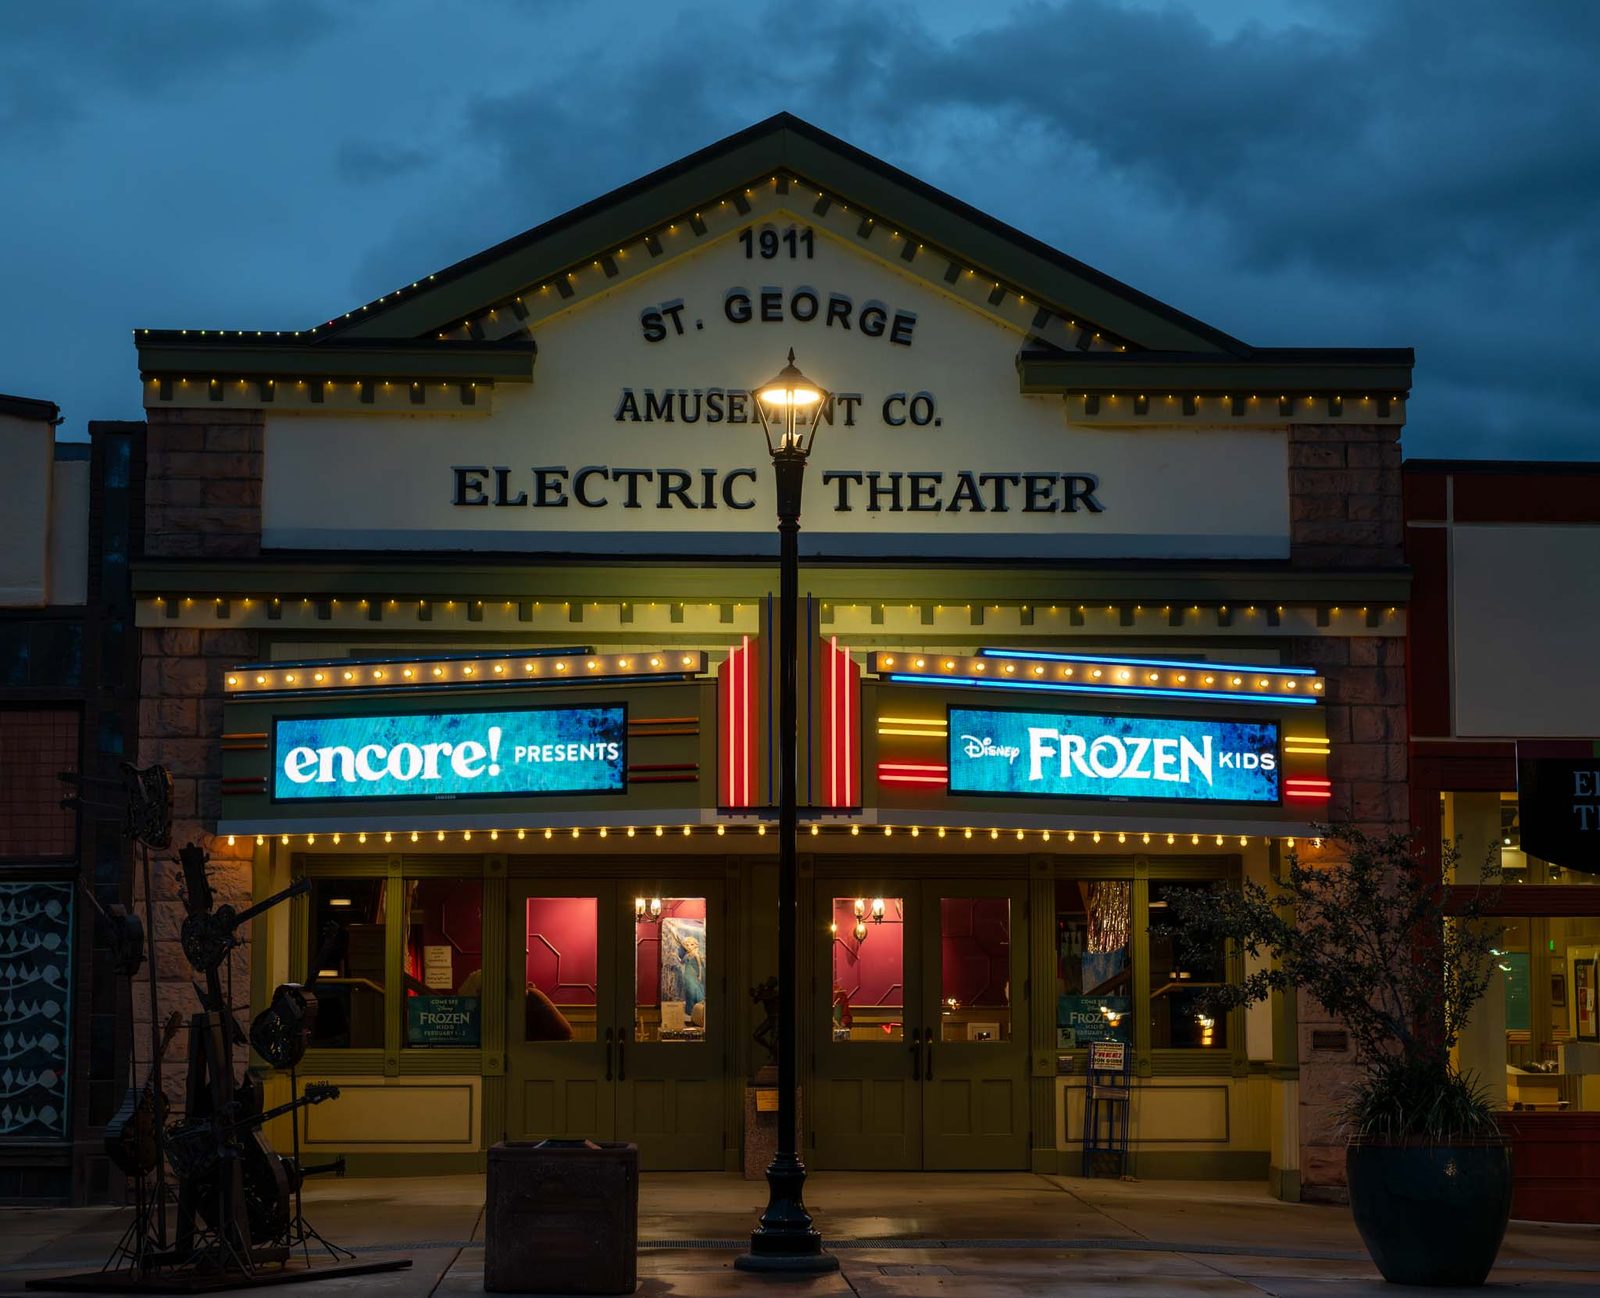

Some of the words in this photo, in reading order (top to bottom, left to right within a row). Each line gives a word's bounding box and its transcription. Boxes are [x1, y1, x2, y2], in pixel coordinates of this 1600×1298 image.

[739, 226, 814, 259] 1911
[641, 299, 704, 342] ST.
[724, 287, 917, 346] GEORGE
[615, 389, 863, 426] AMUSENT
[882, 392, 942, 427] CO.
[453, 467, 758, 509] ELECTRIC
[822, 471, 1105, 513] THEATER
[283, 726, 502, 784] encore!
[515, 742, 619, 763] PRESENTS
[1028, 727, 1213, 787] FROZEN
[1219, 752, 1275, 770] KIDS
[419, 1012, 470, 1025] FROZEN
[1070, 1012, 1109, 1025] FROZE
